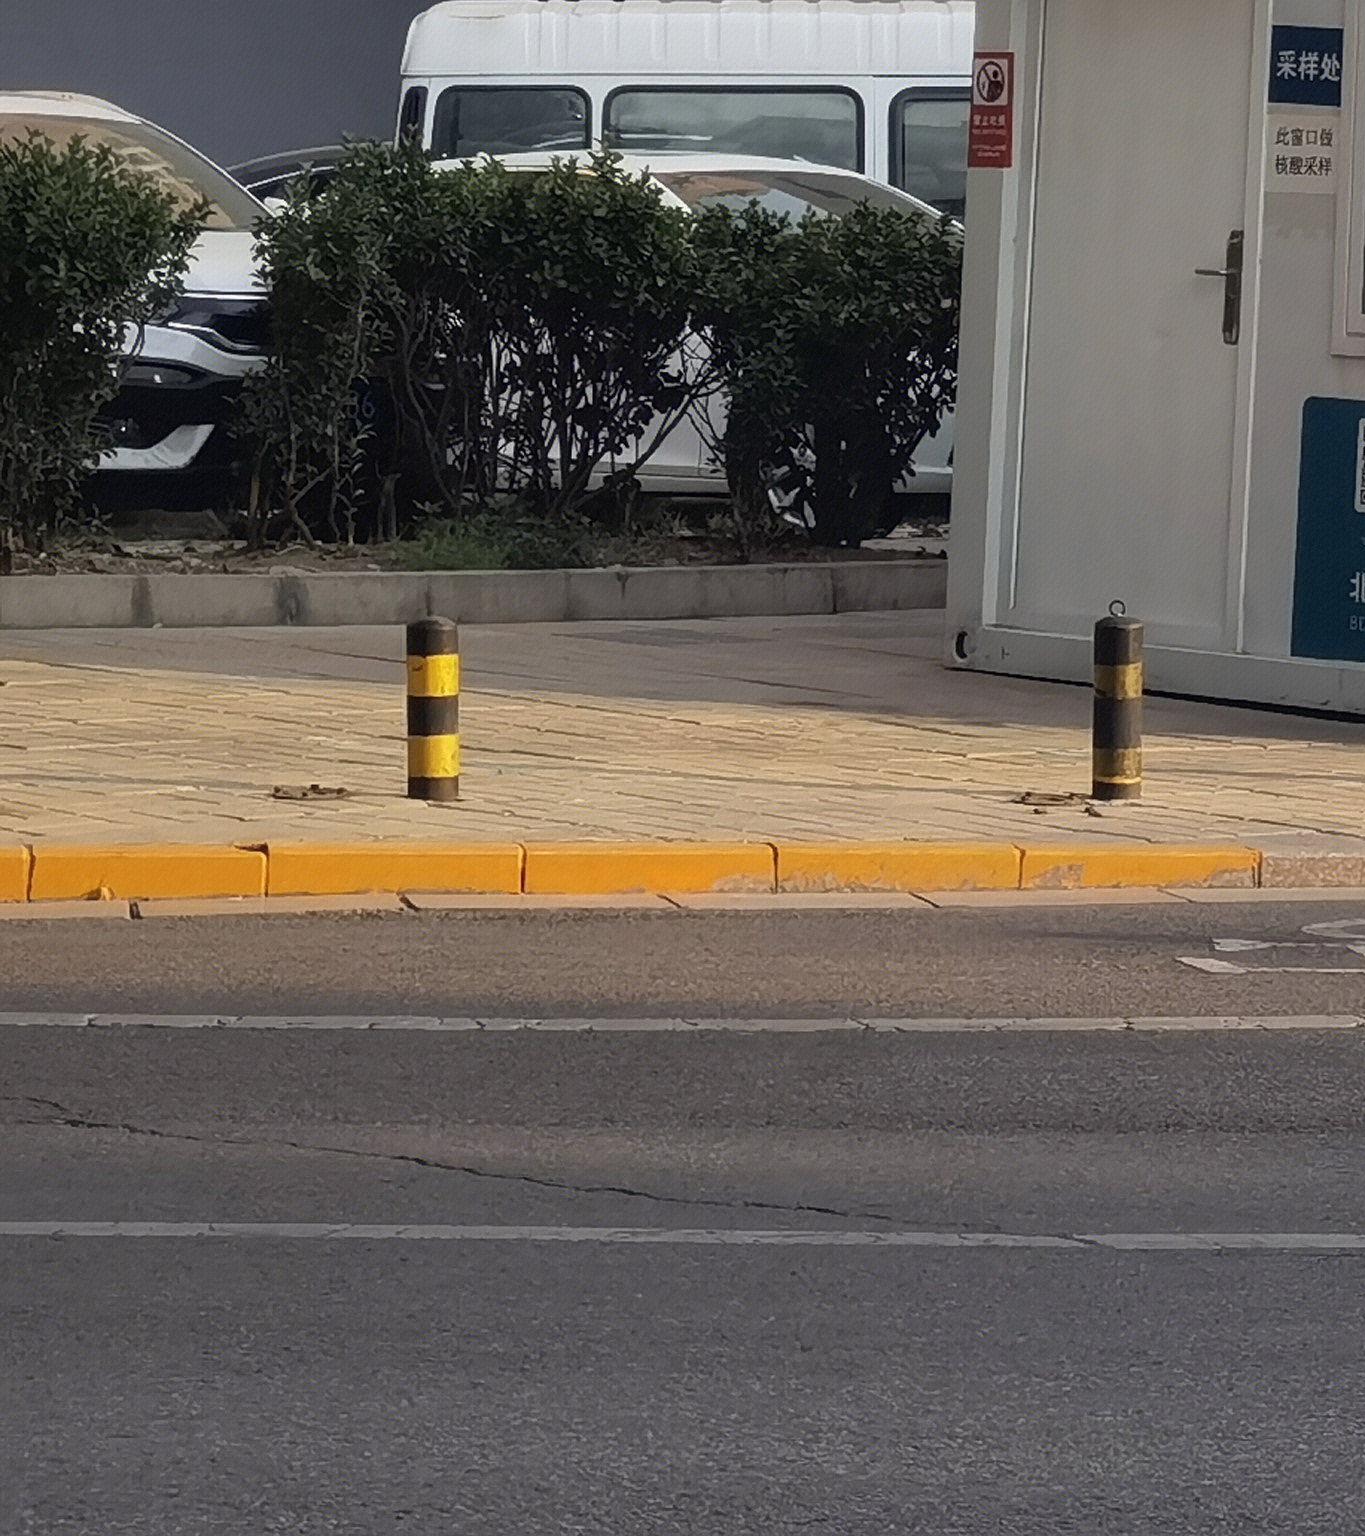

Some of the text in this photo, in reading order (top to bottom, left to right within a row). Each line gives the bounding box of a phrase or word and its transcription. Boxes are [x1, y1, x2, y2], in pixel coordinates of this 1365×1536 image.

[1276, 49, 1341, 82] 采样处
[1274, 154, 1333, 177] 核酸采样
